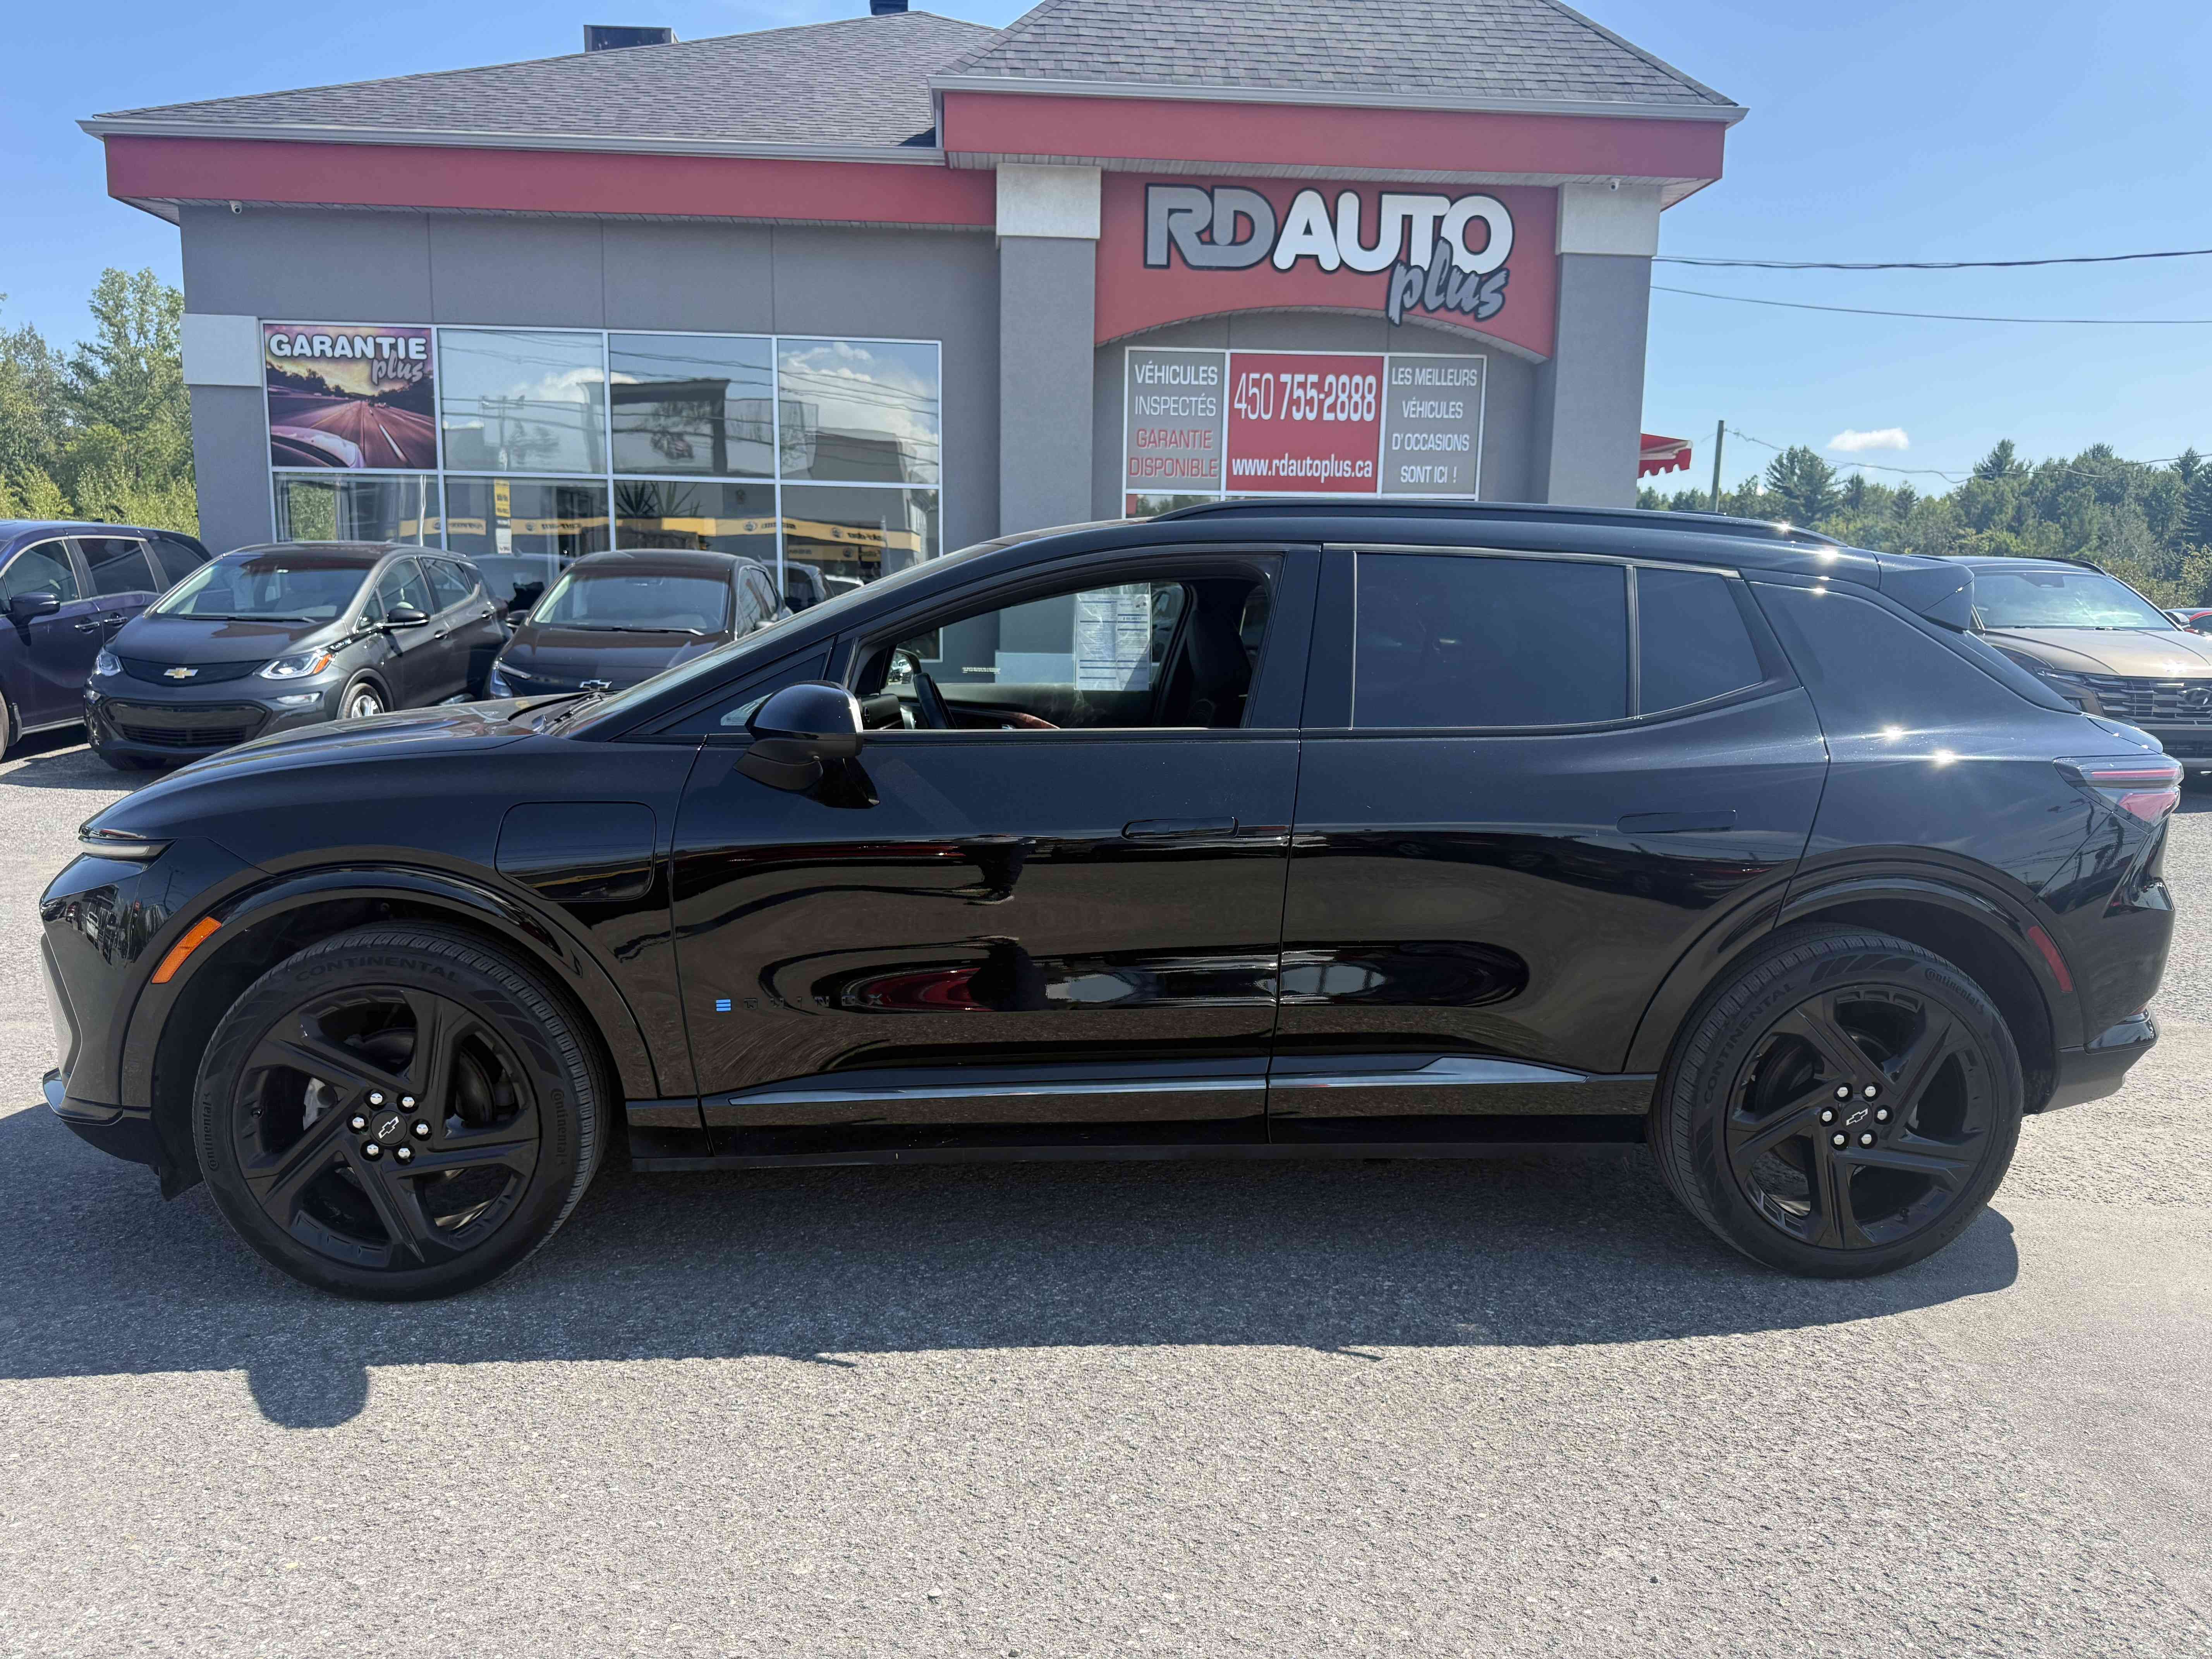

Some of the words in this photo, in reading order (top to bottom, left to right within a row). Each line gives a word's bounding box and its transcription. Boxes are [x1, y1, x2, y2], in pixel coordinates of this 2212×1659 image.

[1388, 235, 1509, 325] plus
[270, 334, 427, 360] GARANTIE
[372, 349, 423, 385] plus
[1135, 359, 1218, 385] VÉHICULES
[1392, 368, 1412, 385] LES
[1415, 368, 1477, 386] MEILLEURS
[1135, 393, 1216, 416] INSPECTÉS
[1234, 373, 1274, 420] 450
[1280, 374, 1376, 421] 755-2888
[1402, 397, 1463, 418] VÉHICULES
[1137, 428, 1213, 449] GARANTIE
[1129, 457, 1218, 478] DISPONIBLE
[1232, 453, 1372, 483] www.rdautoplus.ca
[1401, 465, 1432, 483] SONT
[296, 957, 459, 983] CONTINENTAL
[1704, 982, 1797, 1104] CONTINENTAL
[202, 1101, 220, 1171] Continental
[550, 1088, 568, 1158] Continental
